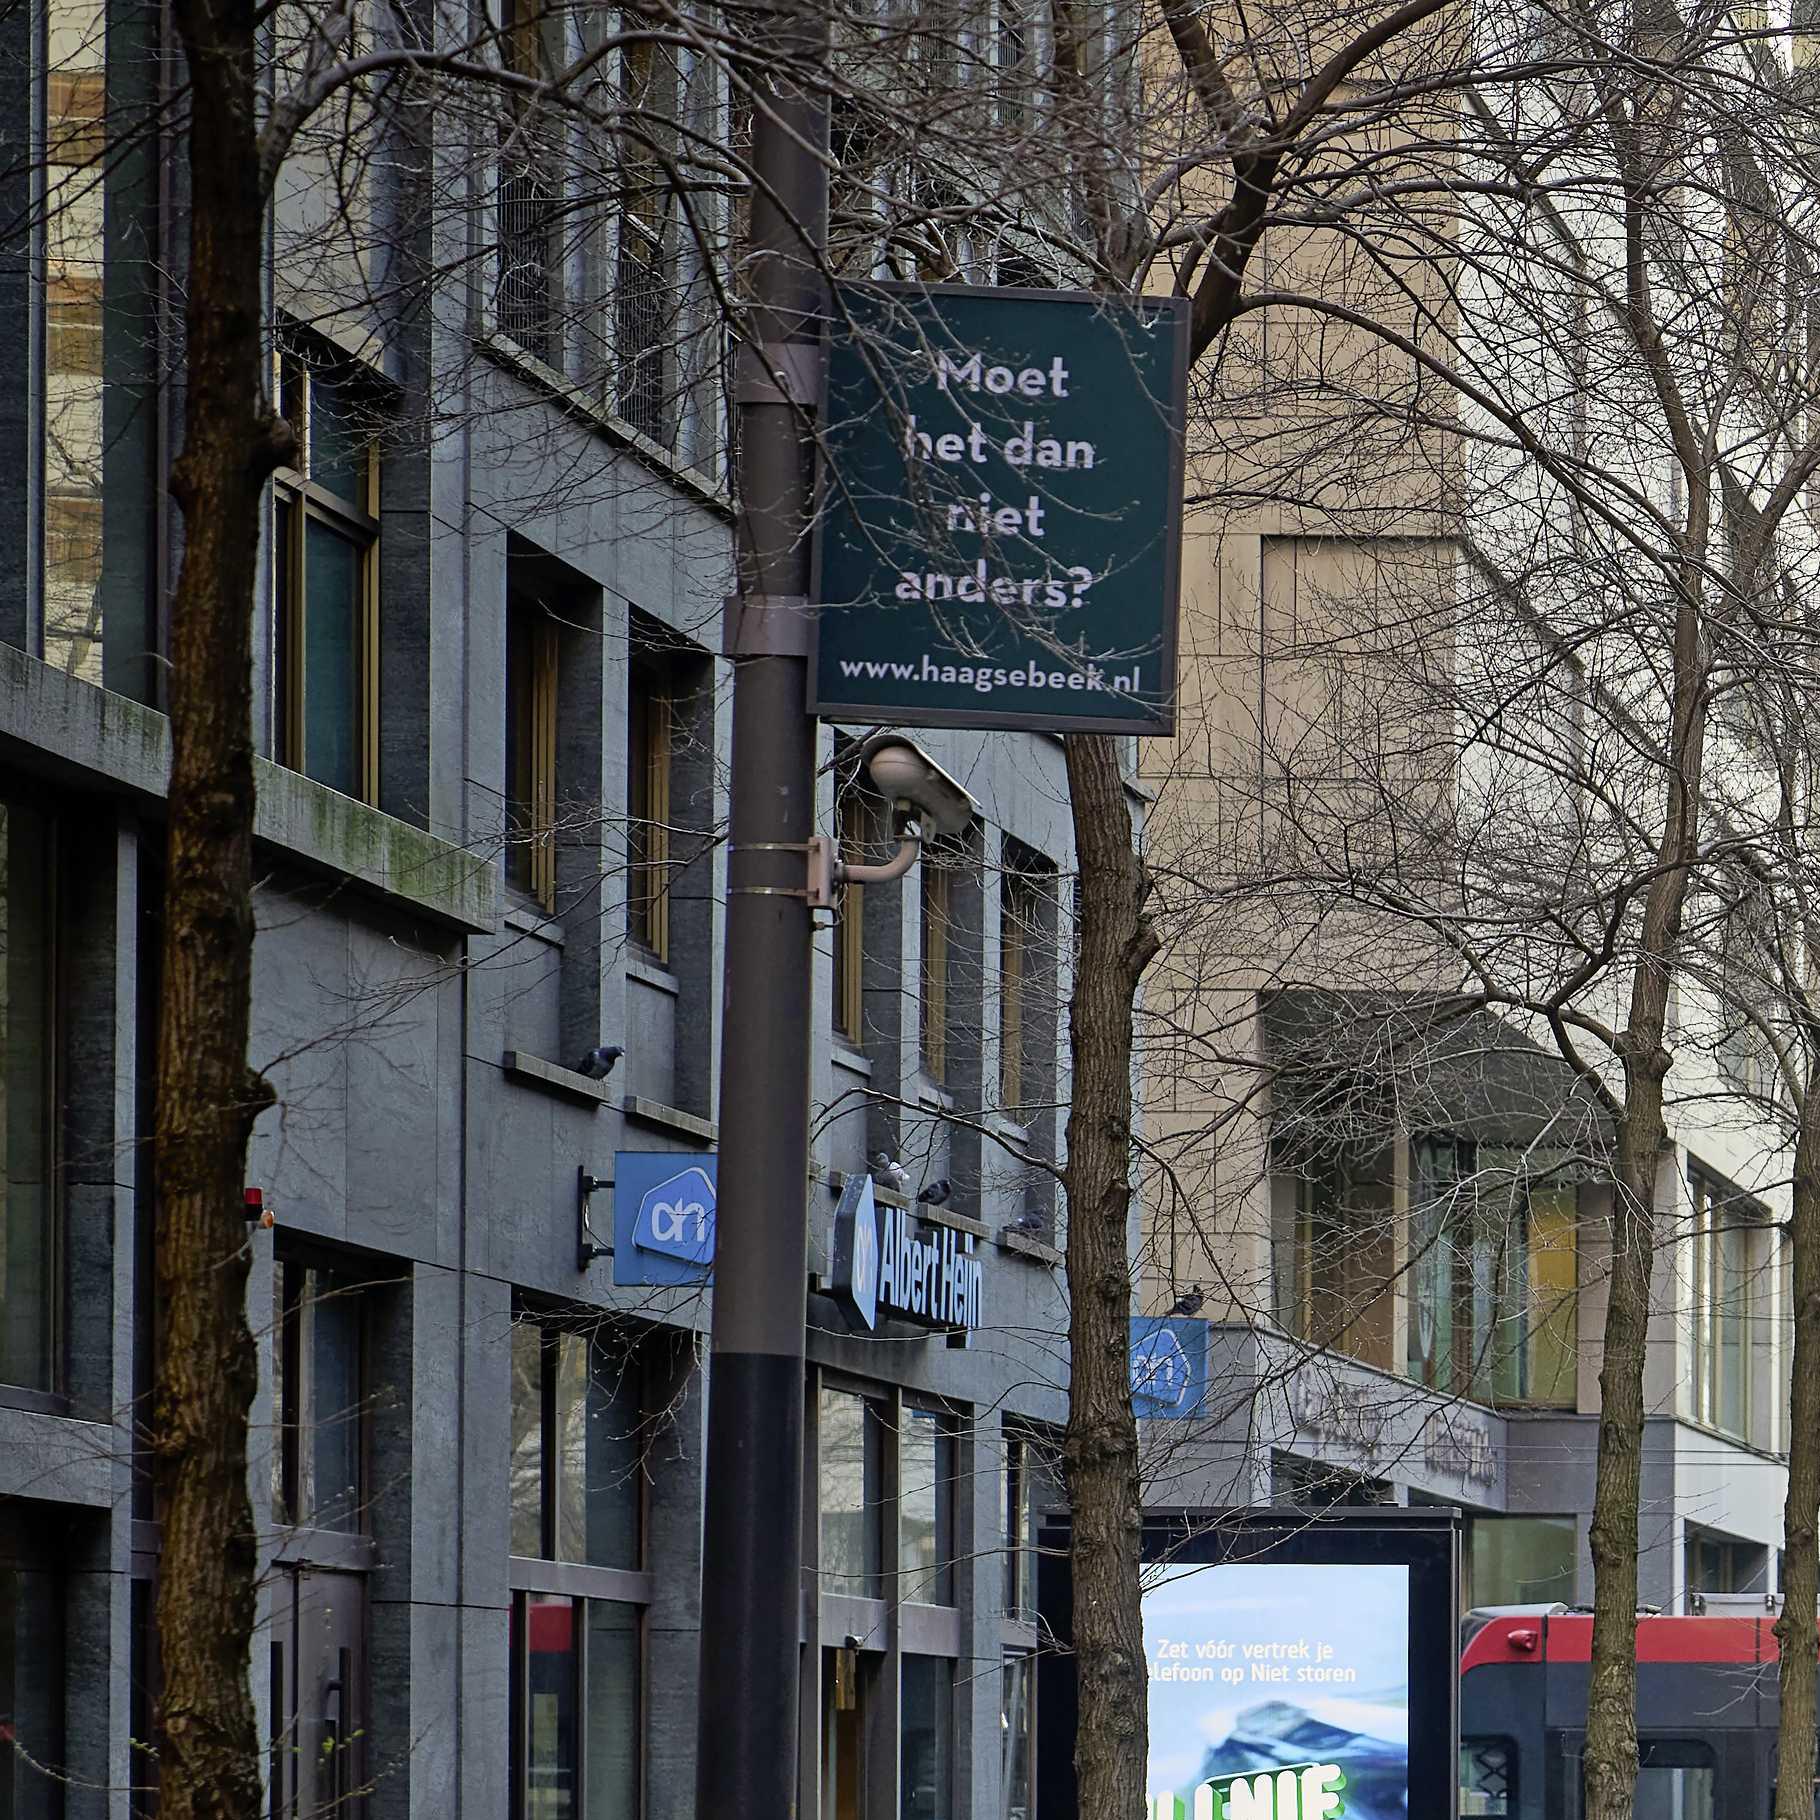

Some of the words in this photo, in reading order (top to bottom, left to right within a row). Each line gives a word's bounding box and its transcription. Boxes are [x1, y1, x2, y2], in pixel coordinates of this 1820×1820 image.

[938, 357, 1070, 397] Moet
[906, 416, 987, 462] het
[1005, 422, 1094, 468] dan
[947, 494, 1045, 537] niet
[896, 561, 1093, 608] anders?
[840, 655, 1141, 693] www.haagsebeek.nl
[880, 1207, 940, 1319] Albert
[941, 1226, 982, 1349] Heijn
[1157, 1640, 1188, 1658] Zet
[1196, 1640, 1234, 1658] vóór
[1242, 1639, 1310, 1658] vertrek
[1316, 1641, 1333, 1663] je
[1148, 1664, 1213, 1682] elefoon
[1221, 1667, 1244, 1685] op
[1251, 1664, 1289, 1682] Niet
[1297, 1665, 1356, 1682] storen
